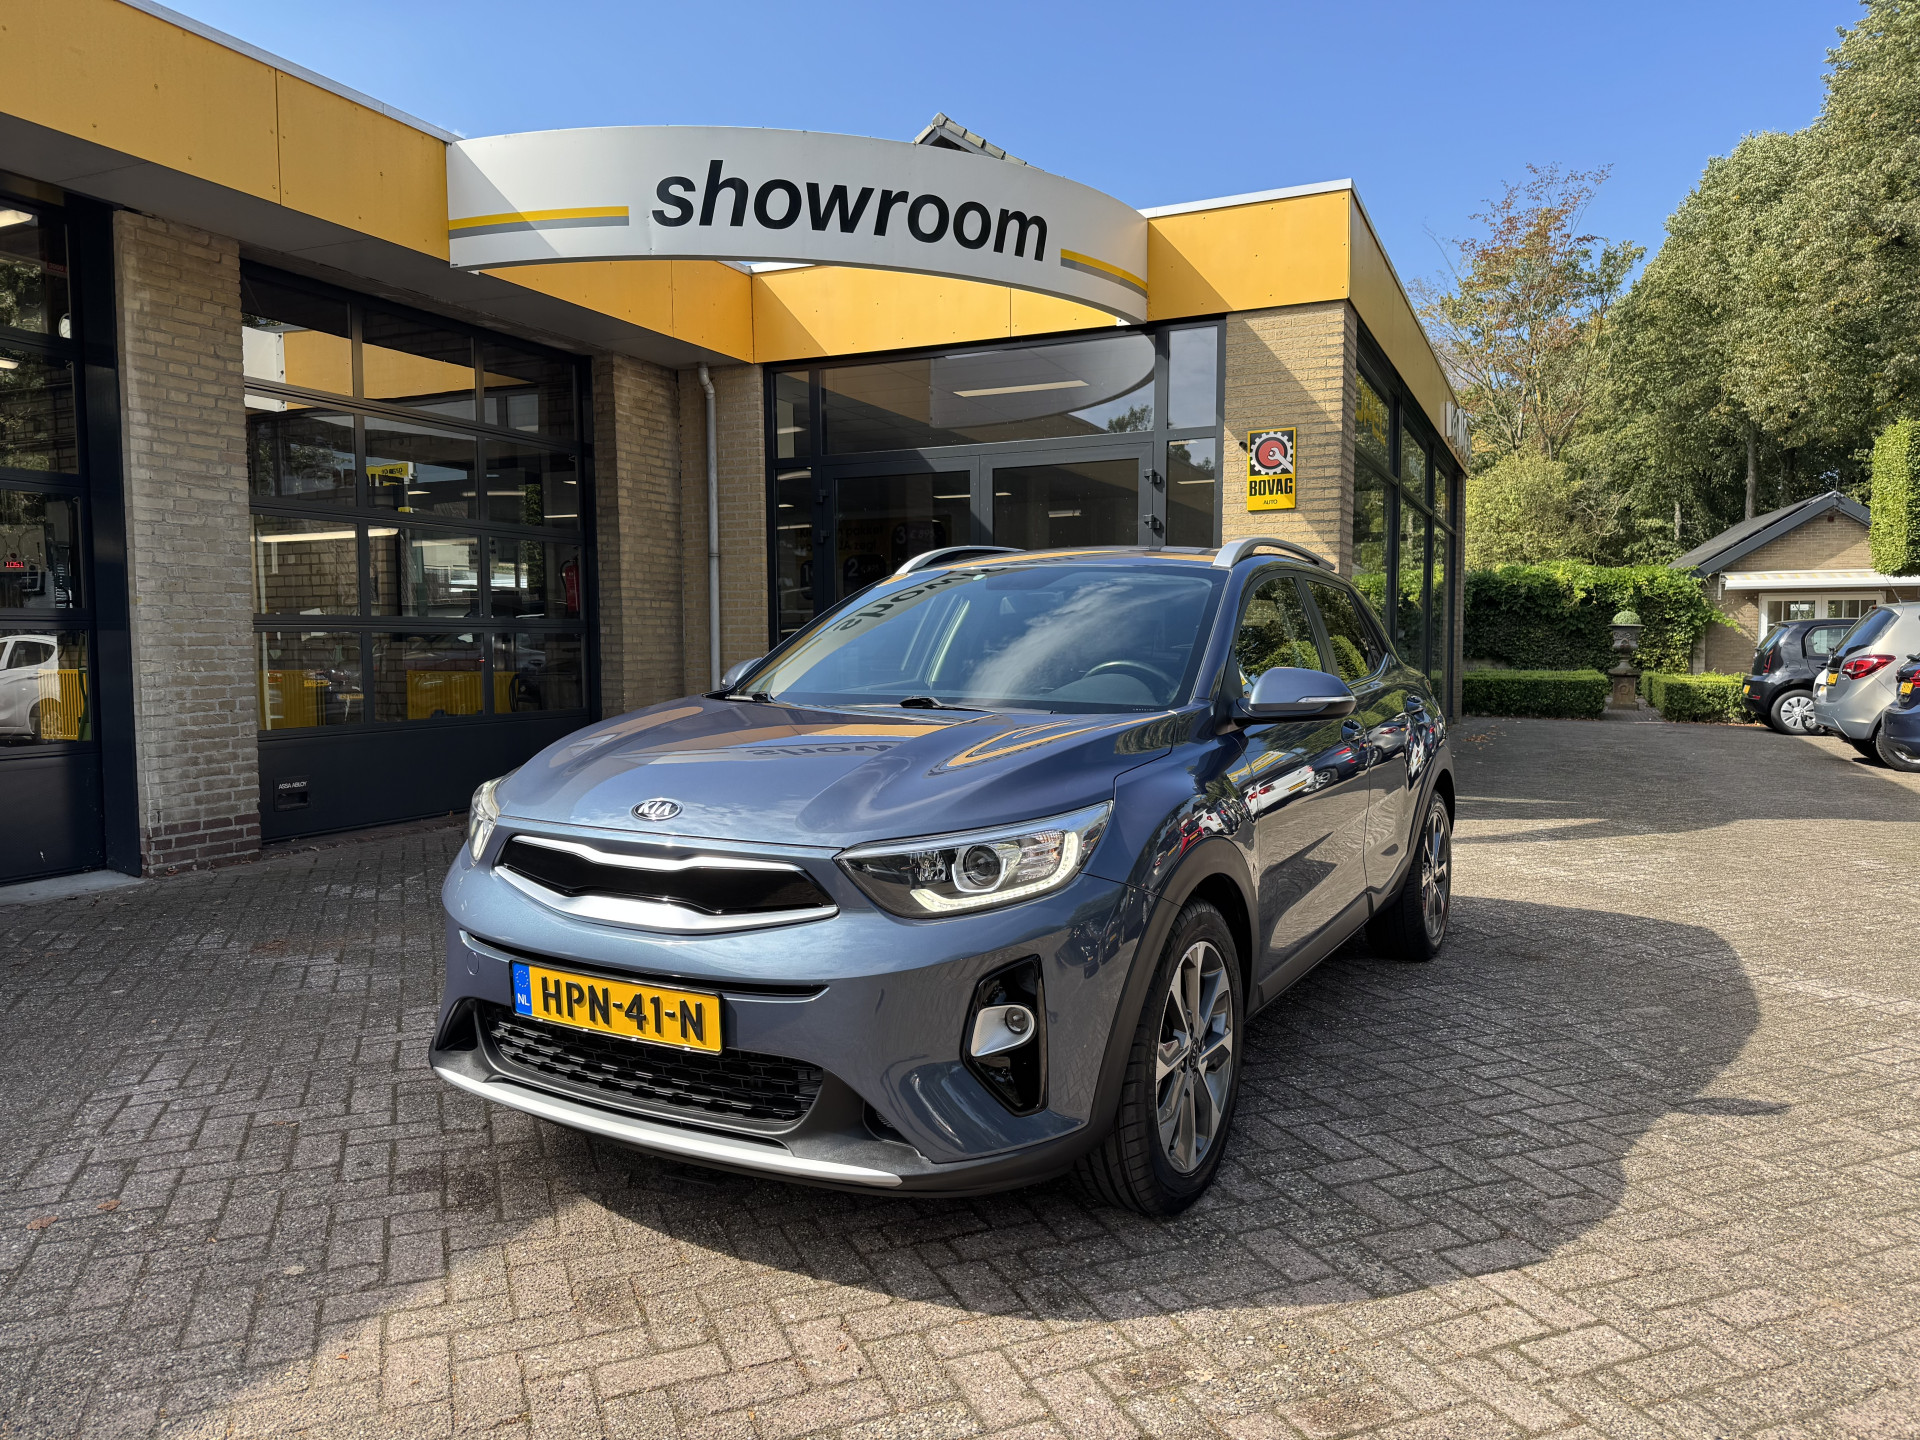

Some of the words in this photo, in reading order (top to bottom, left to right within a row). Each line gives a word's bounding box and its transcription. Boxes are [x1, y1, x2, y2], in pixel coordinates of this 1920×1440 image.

[652, 160, 1047, 262] showroom
[1249, 478, 1293, 496] BOVAG
[896, 526, 906, 544] 3
[848, 558, 859, 576] 2
[637, 801, 672, 816] KIA
[518, 993, 530, 1006] NL
[541, 976, 703, 1042] HPN-41-N
